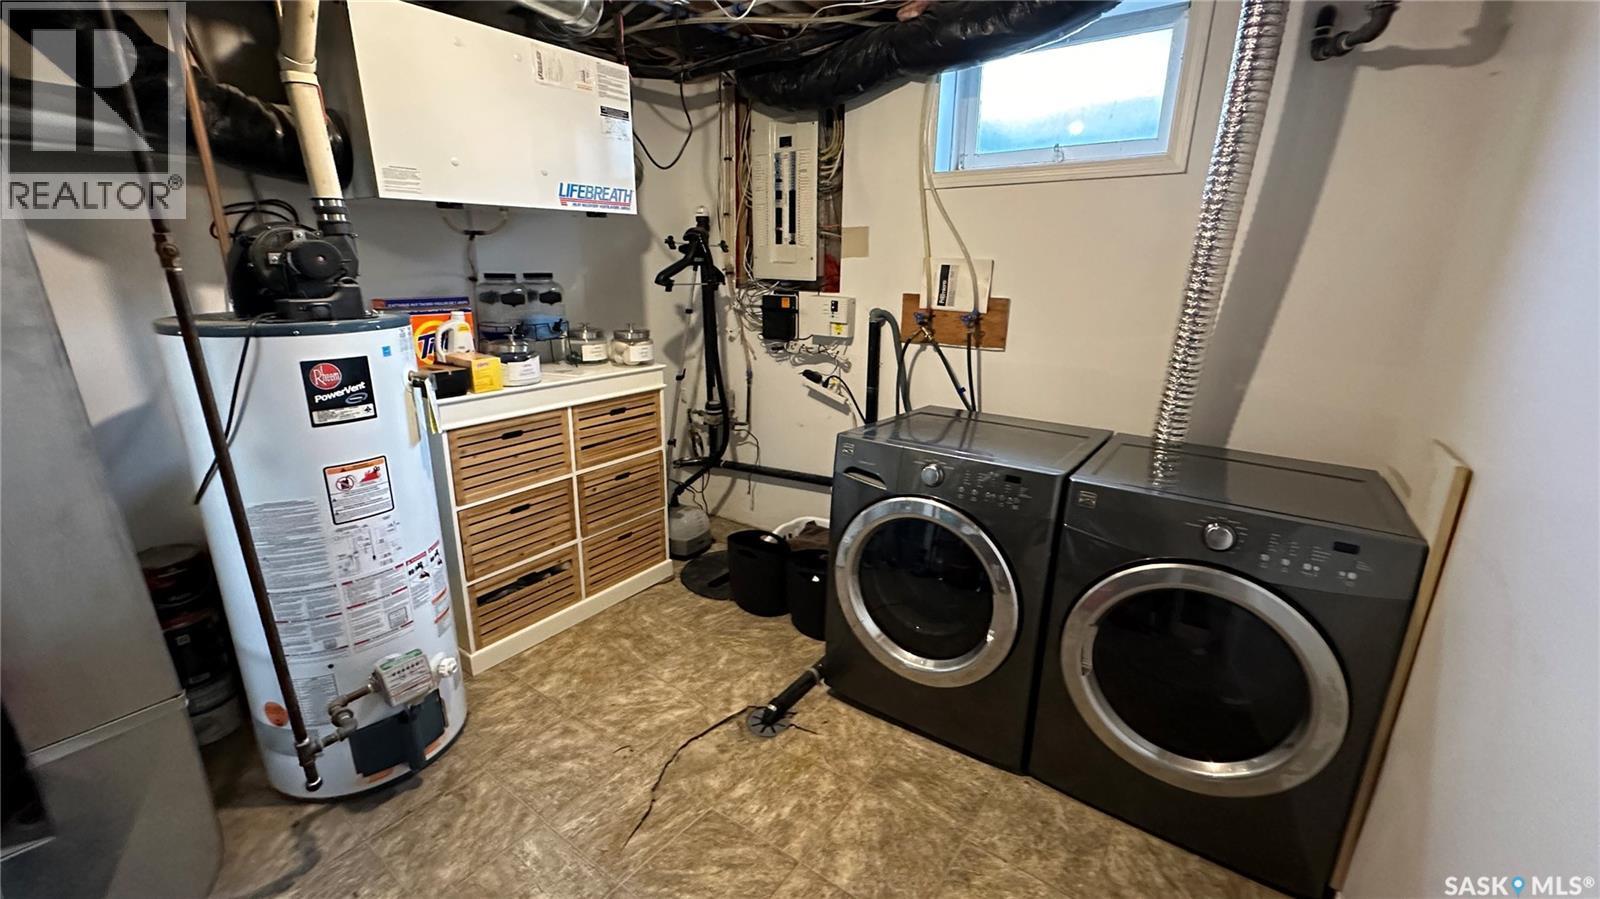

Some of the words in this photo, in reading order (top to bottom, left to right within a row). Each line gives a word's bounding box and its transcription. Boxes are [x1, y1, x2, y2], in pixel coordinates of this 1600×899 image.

[558, 182, 633, 203] LIFEBREATH
[417, 330, 450, 360] Ti
[314, 381, 366, 404] PowerVent
